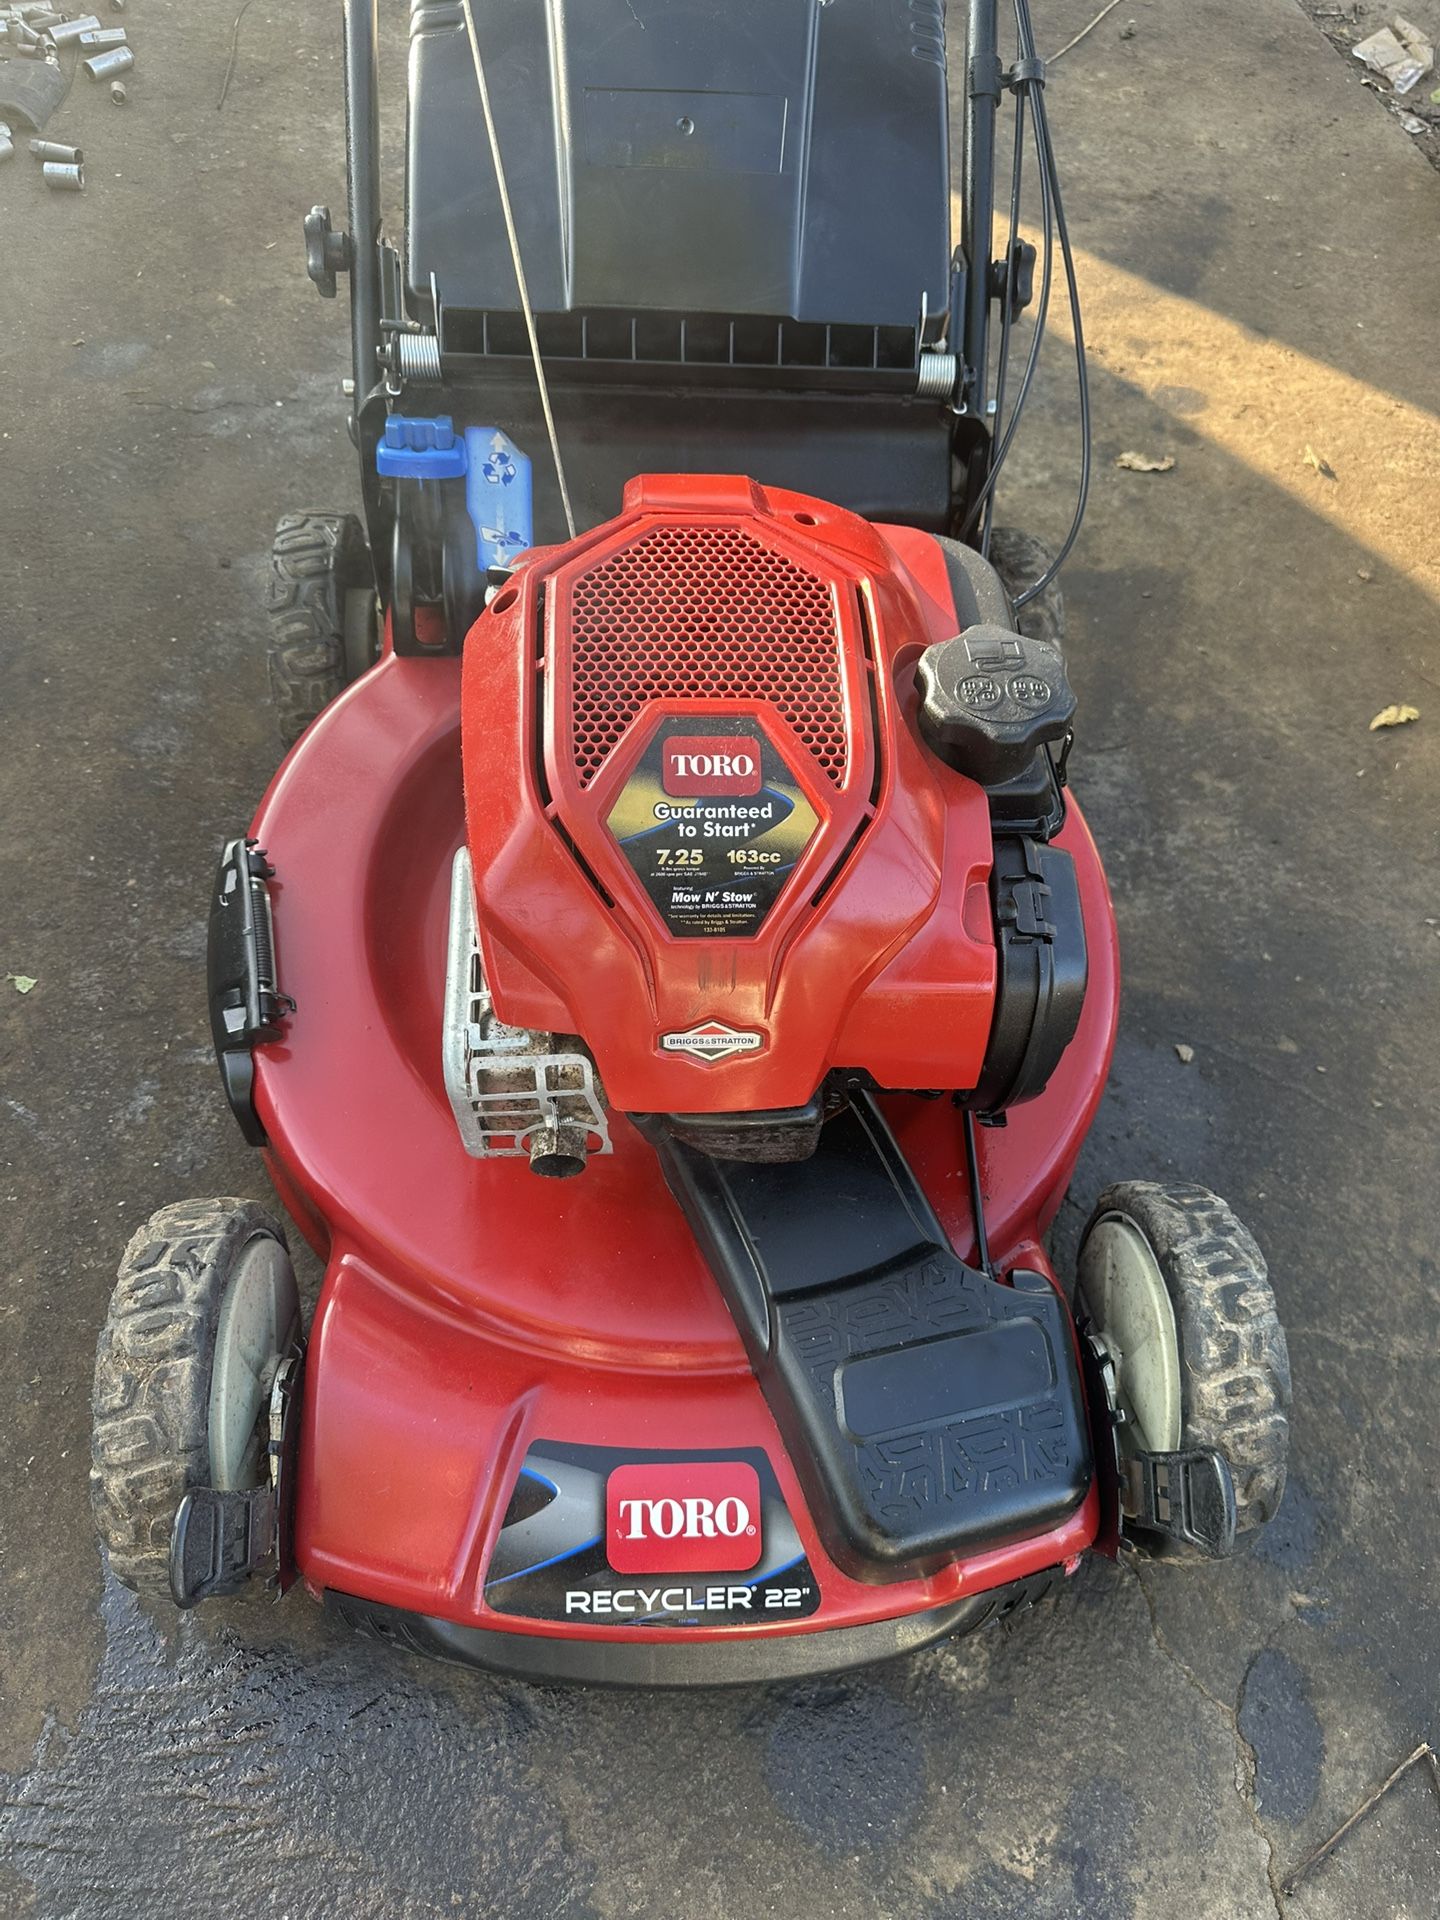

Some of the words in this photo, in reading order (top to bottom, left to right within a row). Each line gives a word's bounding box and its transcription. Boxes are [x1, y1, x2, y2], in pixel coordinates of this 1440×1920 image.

[654, 802, 773, 819] Guaranteed
[677, 822, 697, 837] to
[656, 848, 704, 865] 7.25
[726, 849, 781, 863] 163cc
[671, 892, 701, 902] Mow
[705, 891, 719, 902] N'
[764, 1587, 811, 1609] 22"
